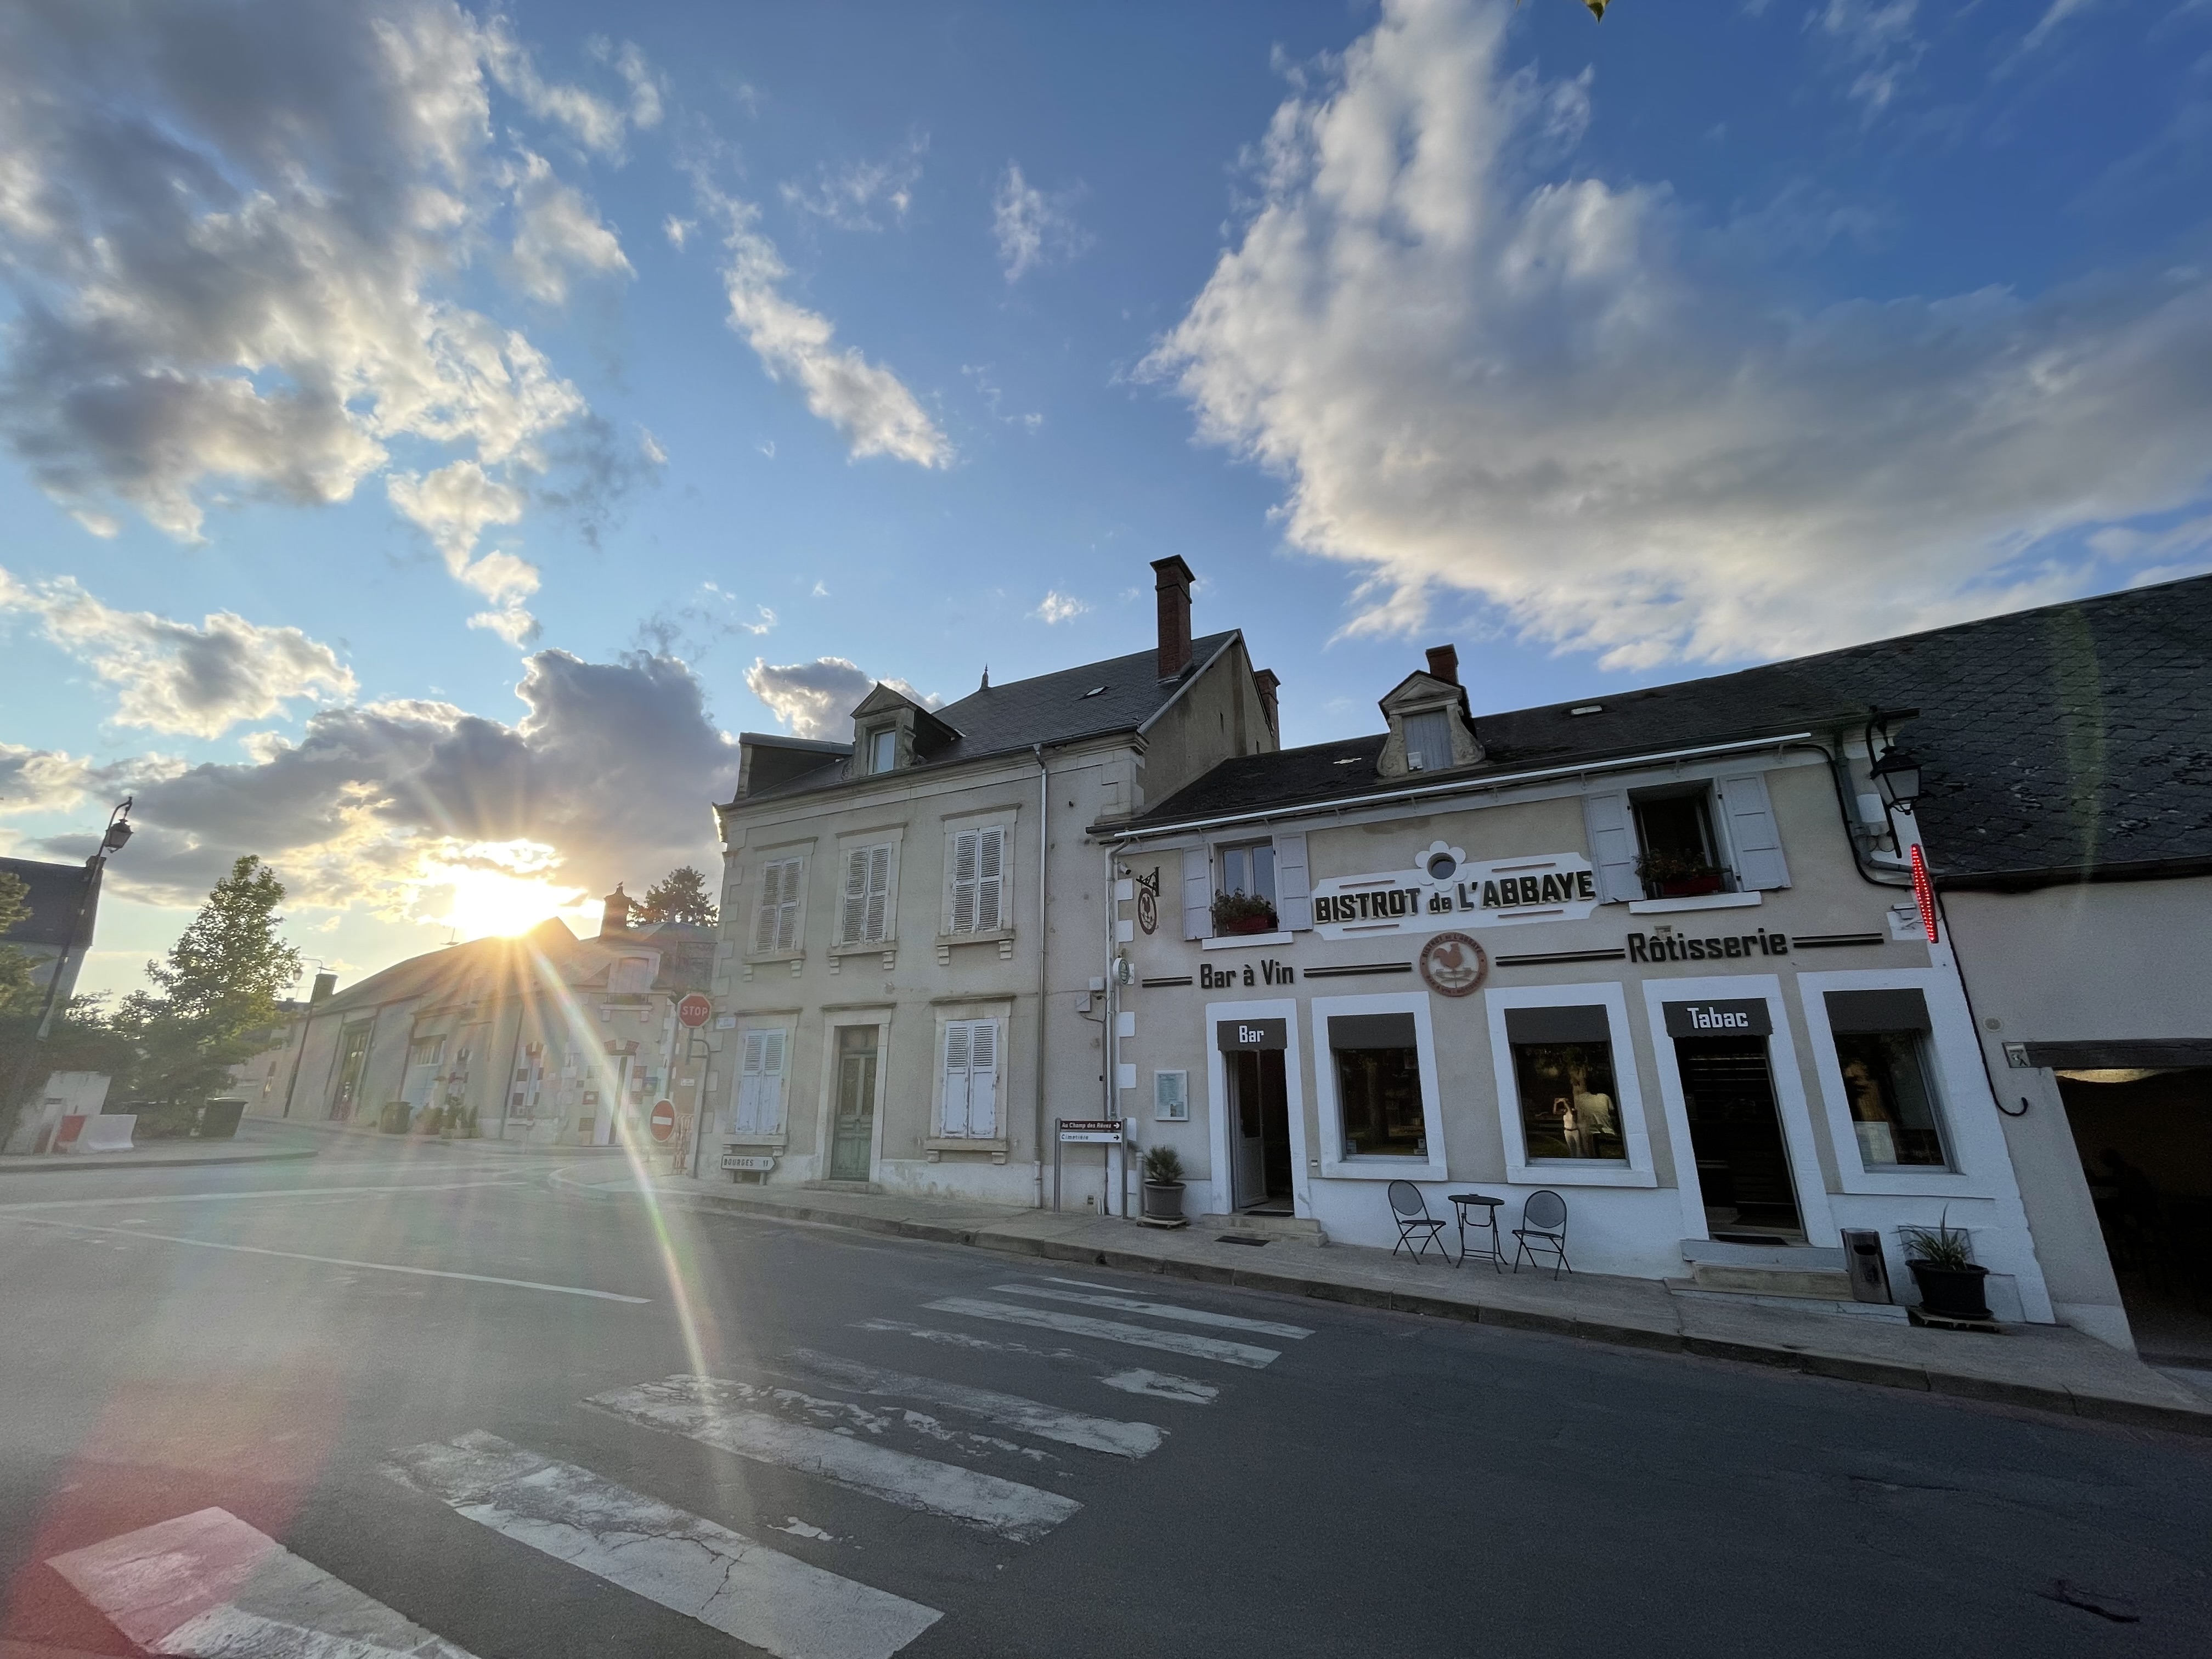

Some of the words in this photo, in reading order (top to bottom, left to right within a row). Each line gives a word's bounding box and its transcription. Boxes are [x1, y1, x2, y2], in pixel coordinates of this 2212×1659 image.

[1314, 888, 1421, 922] BISTROT
[1429, 892, 1452, 912] de
[1457, 870, 1596, 910] L'ABBAYE
[1627, 927, 1788, 962] Rôtisserie
[1200, 963, 1237, 989] Bar
[1243, 964, 1255, 986] à
[1261, 959, 1294, 985] Vin
[681, 1006, 709, 1017] STOP
[1686, 1007, 1749, 1029] Tabac
[1239, 1025, 1265, 1043] Bar
[724, 1158, 754, 1166] BOURGES
